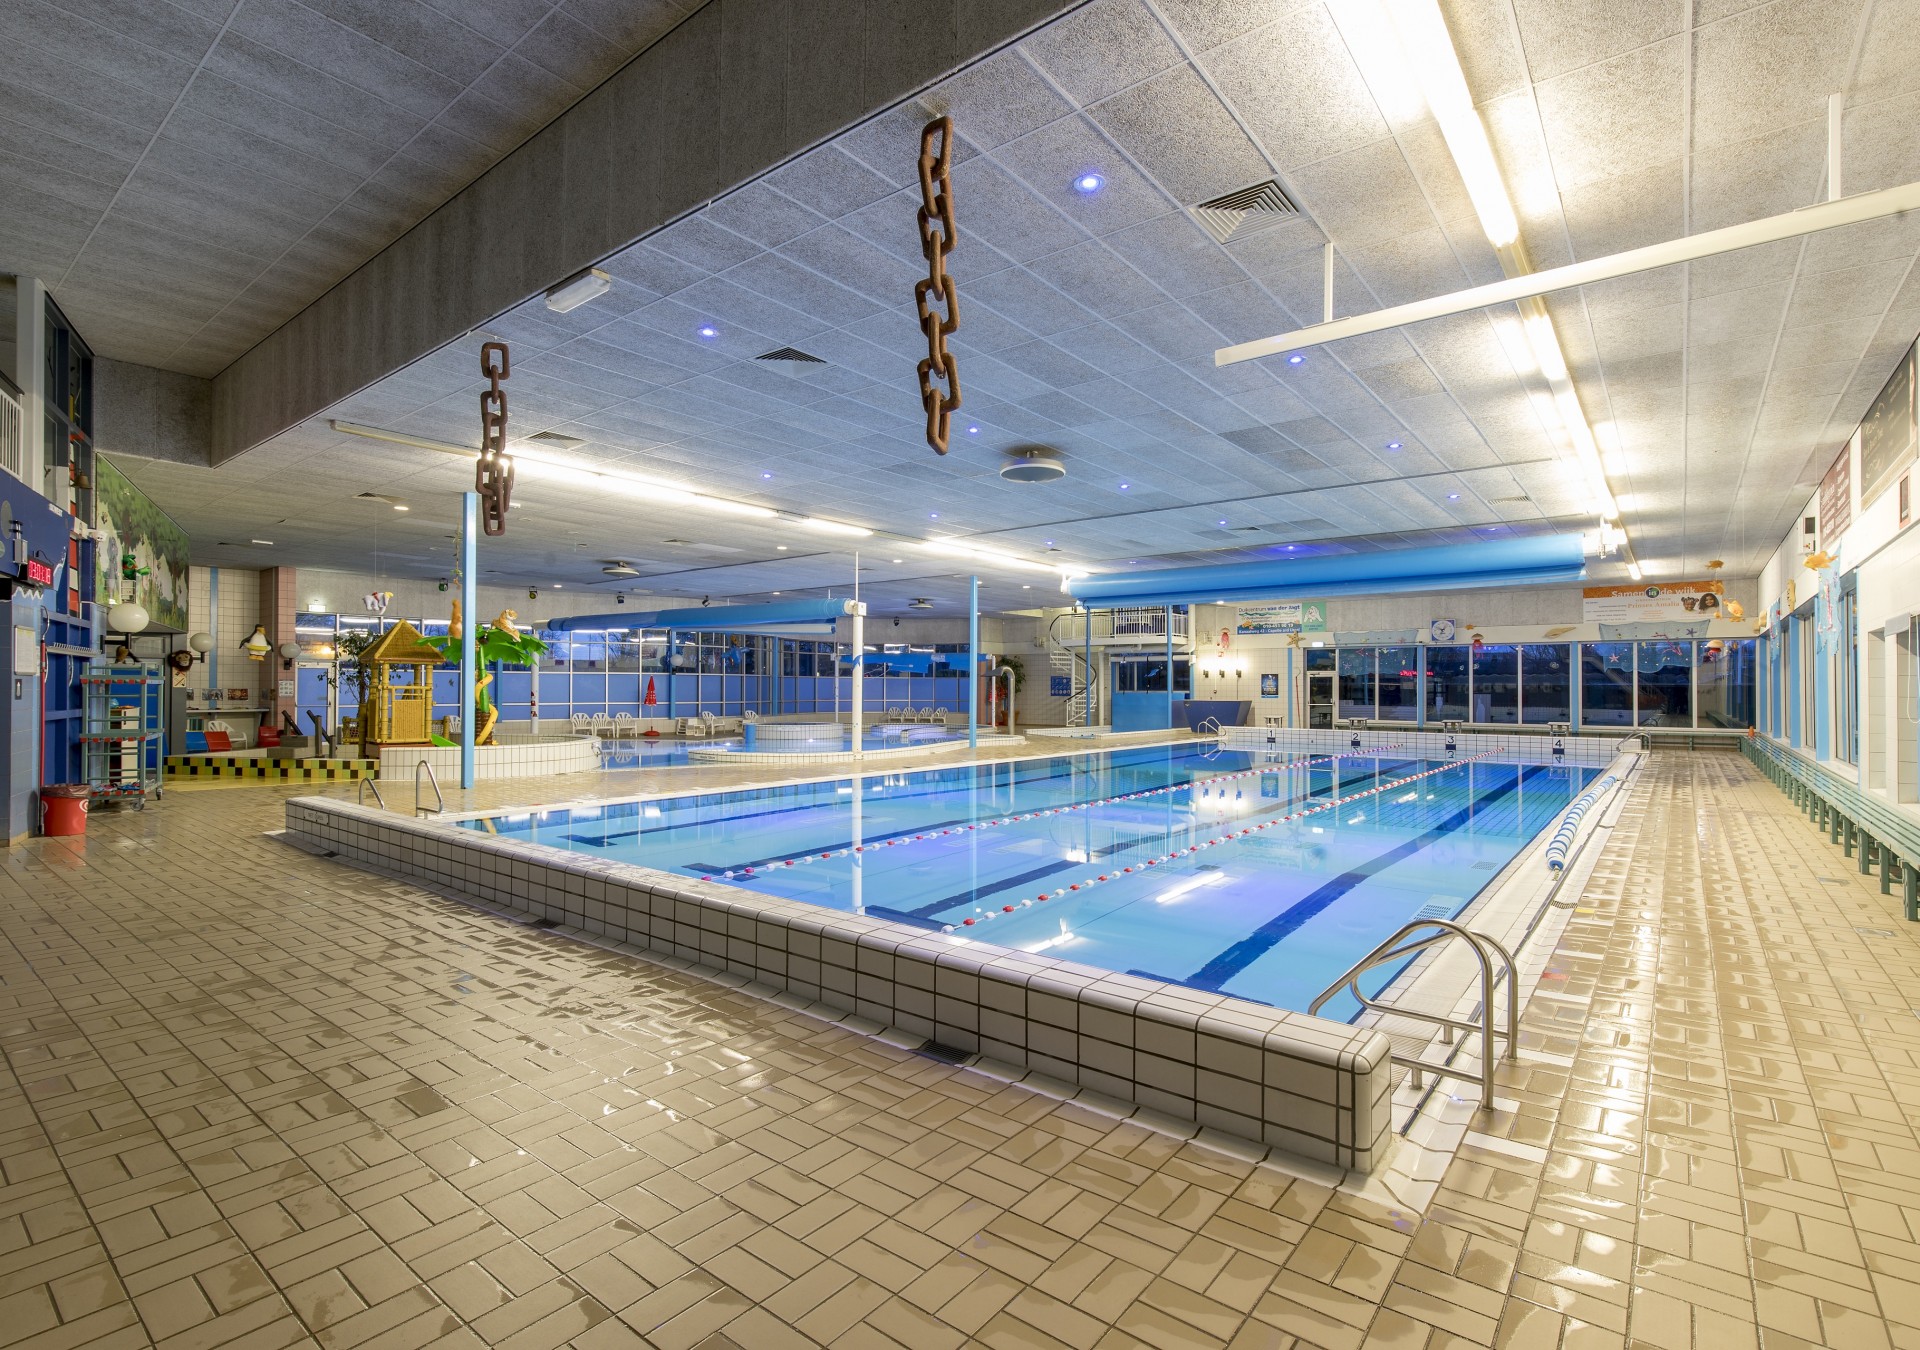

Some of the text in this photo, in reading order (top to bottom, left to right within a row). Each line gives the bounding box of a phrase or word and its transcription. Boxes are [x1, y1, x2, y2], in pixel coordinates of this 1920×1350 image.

[1611, 586, 1696, 598] Samen in de wijk
